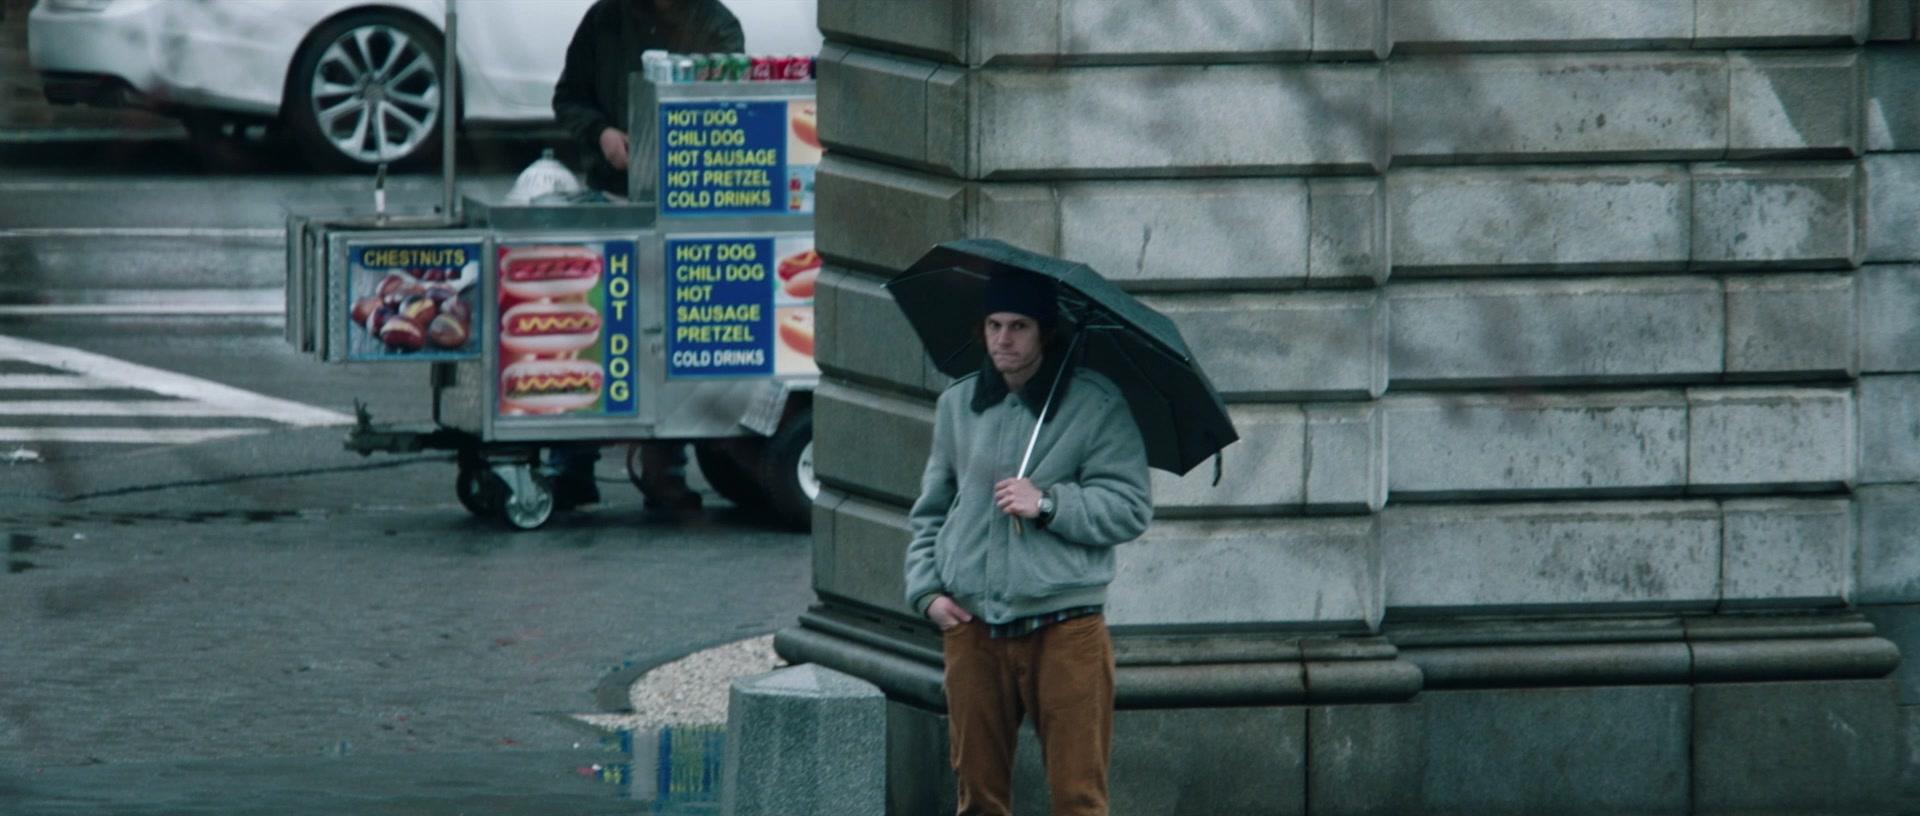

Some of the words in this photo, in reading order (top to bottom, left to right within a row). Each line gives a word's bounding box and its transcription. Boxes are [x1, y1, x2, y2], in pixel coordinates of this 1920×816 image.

[667, 110, 698, 126] HOT
[703, 110, 738, 126] DOG
[667, 130, 706, 146] CHILI
[711, 130, 745, 146] DOG
[667, 150, 699, 166] HOT
[703, 149, 776, 166] SAUSAGE
[667, 171, 699, 187] HOT
[703, 170, 771, 187] PRETZEL
[667, 191, 710, 207] COLD
[714, 190, 771, 207] DRINKS
[363, 249, 465, 267] CHESTNUTS
[676, 245, 712, 261] HOT
[717, 244, 756, 261] DOG
[676, 265, 721, 282] CHILI
[726, 264, 765, 281] DOG
[609, 255, 630, 320] HOT
[676, 286, 712, 302] HOT
[677, 305, 760, 323] SAUSAGE
[677, 325, 754, 343] PRETZEL
[673, 351, 710, 367] COLD
[714, 349, 765, 366] DRINKS
[609, 334, 630, 402] DOG
